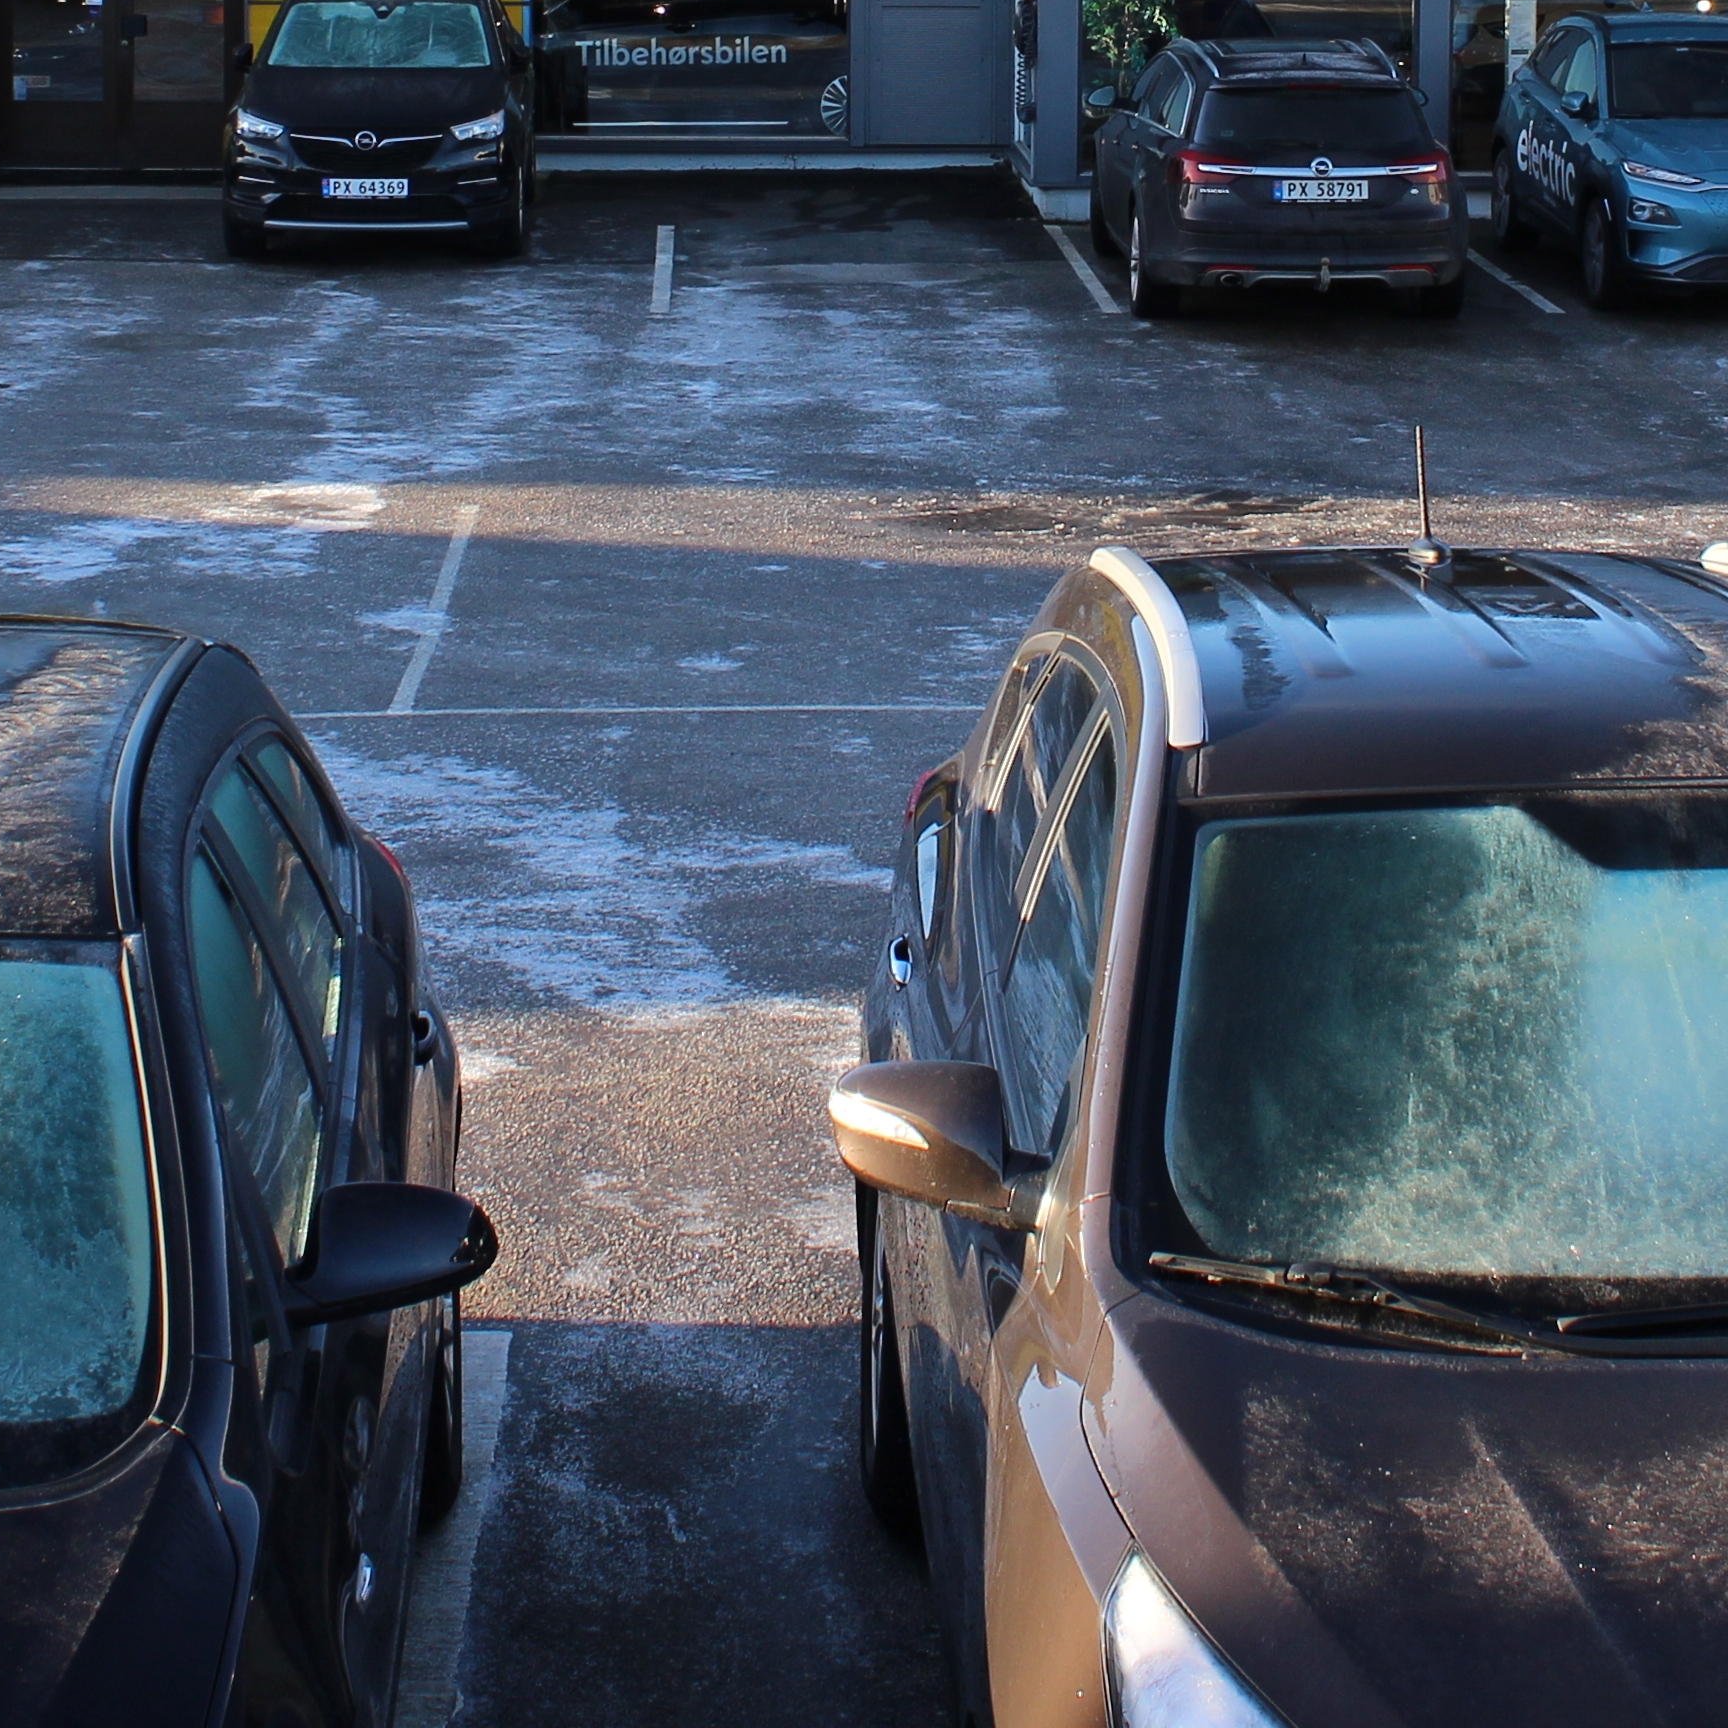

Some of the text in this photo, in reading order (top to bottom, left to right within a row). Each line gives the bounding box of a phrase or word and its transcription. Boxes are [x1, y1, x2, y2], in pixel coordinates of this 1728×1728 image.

[574, 35, 787, 67] Tilbehørsbilen
[1516, 120, 1576, 207] electric
[333, 180, 405, 194] PX 64369
[1287, 182, 1364, 198] PX 58791
